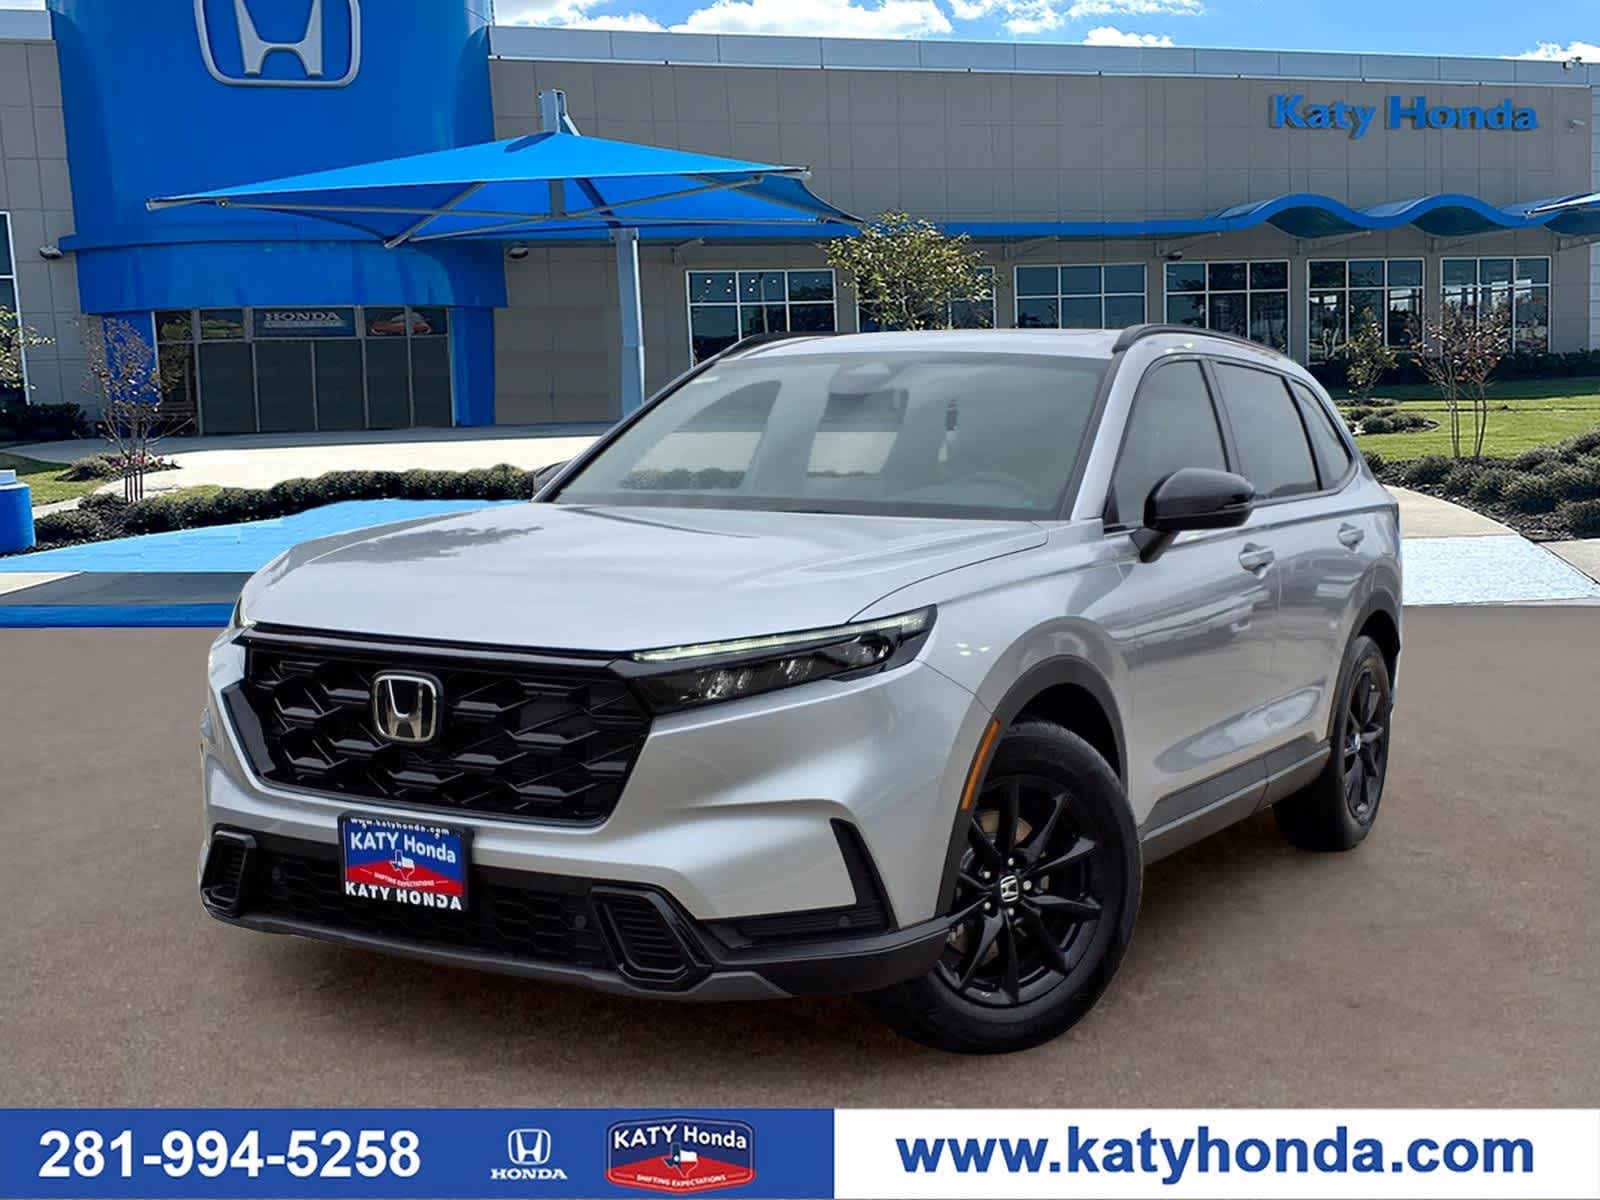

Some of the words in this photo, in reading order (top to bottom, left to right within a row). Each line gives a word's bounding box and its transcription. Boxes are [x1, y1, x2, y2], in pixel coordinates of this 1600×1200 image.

[1269, 94, 1376, 139] Katy
[1385, 95, 1540, 131] Honda
[264, 311, 342, 321] HONDA
[350, 831, 399, 851] KATY
[404, 833, 457, 864] Honda
[345, 881, 390, 901] KATY
[396, 888, 463, 911] HONDA
